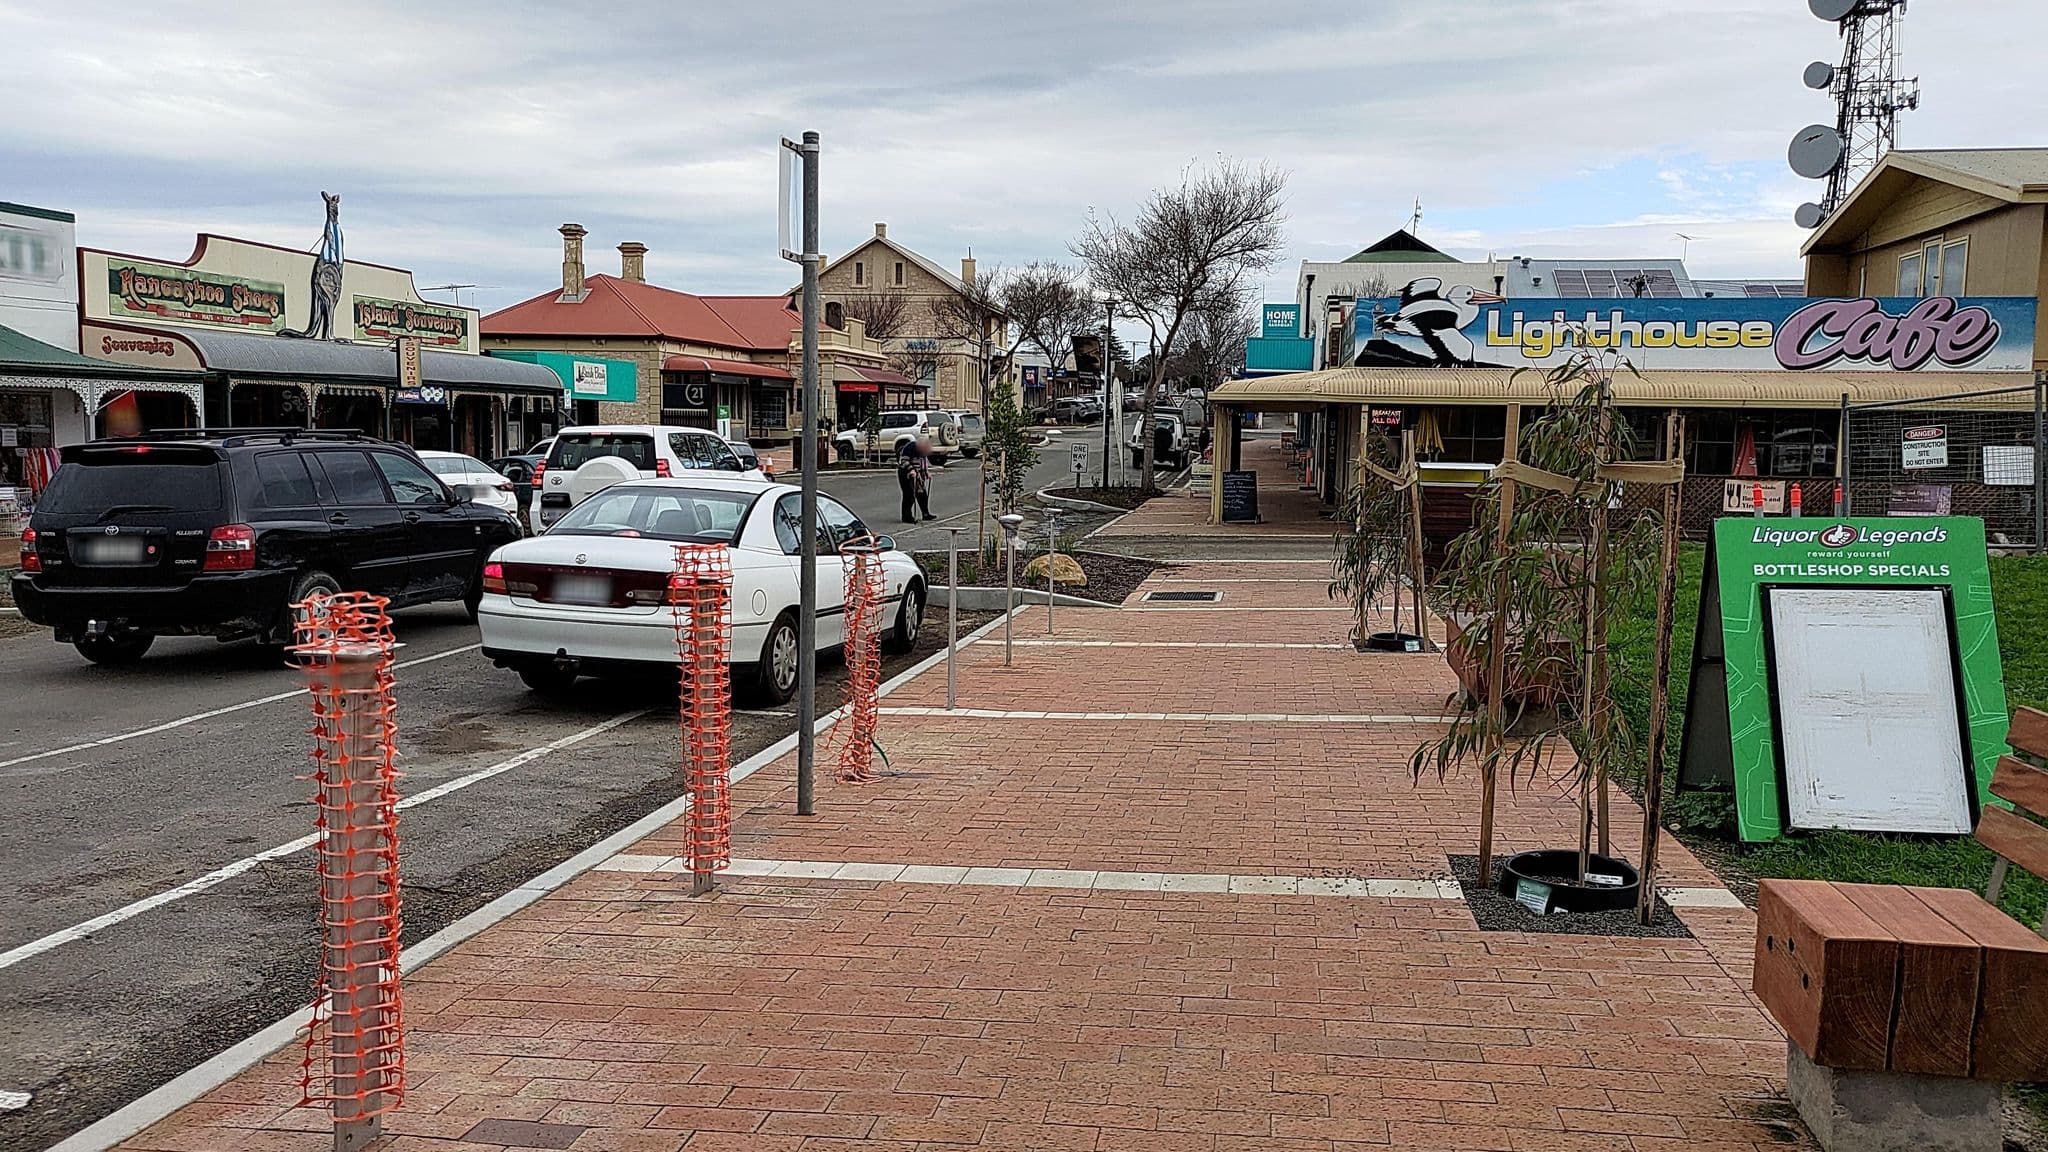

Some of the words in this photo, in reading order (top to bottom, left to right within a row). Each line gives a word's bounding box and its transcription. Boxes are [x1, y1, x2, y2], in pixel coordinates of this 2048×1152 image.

[231, 284, 280, 318] Shoes
[358, 301, 399, 328] Island
[405, 307, 463, 338] Souvenirs
[1266, 311, 1296, 320] HOME
[1486, 310, 1773, 357] Lighthouse
[1773, 296, 2001, 371] Cafe
[102, 336, 175, 357] Souvenirs
[405, 341, 416, 386] SOUVENIRS
[691, 387, 703, 399] 21
[1909, 429, 1938, 438] DANGER
[1903, 441, 1946, 450] CONSTRUCTION
[1751, 526, 1819, 547] Liquor
[1858, 526, 1947, 547] Legends
[1847, 550, 1890, 559] yourself
[1753, 564, 1864, 576] BOTTLESHOP
[1869, 565, 1950, 577] SPECIALS
